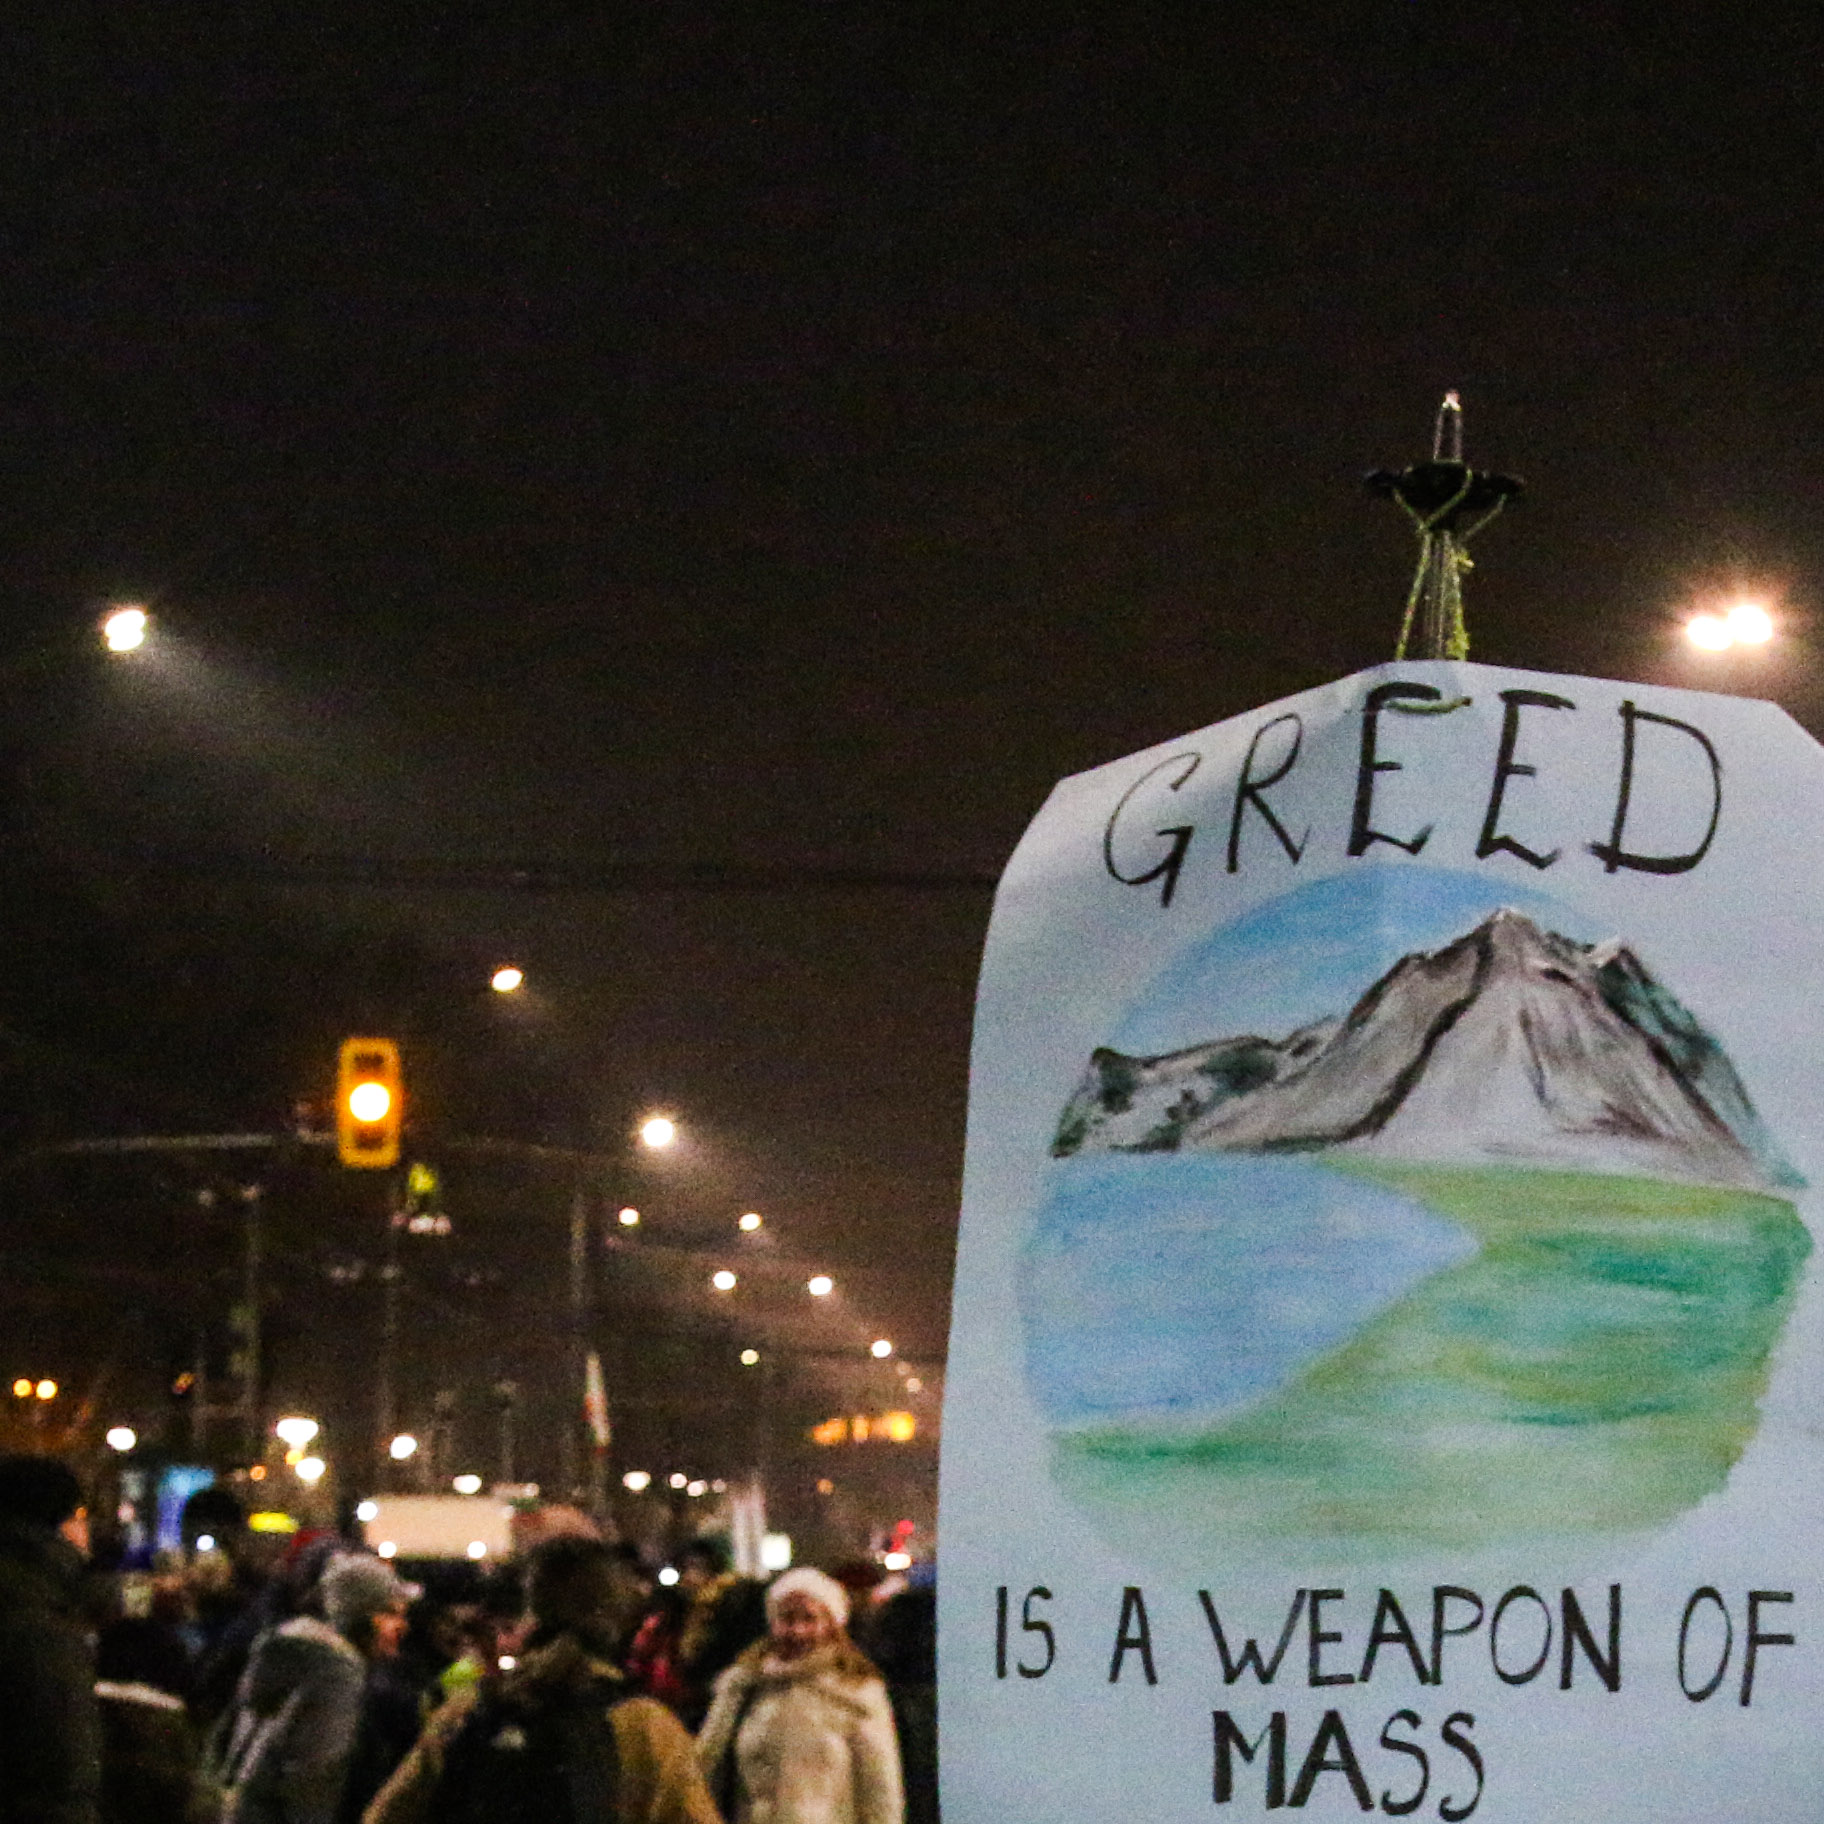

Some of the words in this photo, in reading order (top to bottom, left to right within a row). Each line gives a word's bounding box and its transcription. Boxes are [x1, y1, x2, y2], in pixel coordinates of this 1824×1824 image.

[1102, 681, 1722, 908] GREED
[995, 1585, 1056, 1680] IS
[1108, 1586, 1159, 1686] A
[1197, 1583, 1622, 1693] WEAPON
[1677, 1585, 1795, 1708] OF
[1211, 1708, 1485, 1822] MASS
